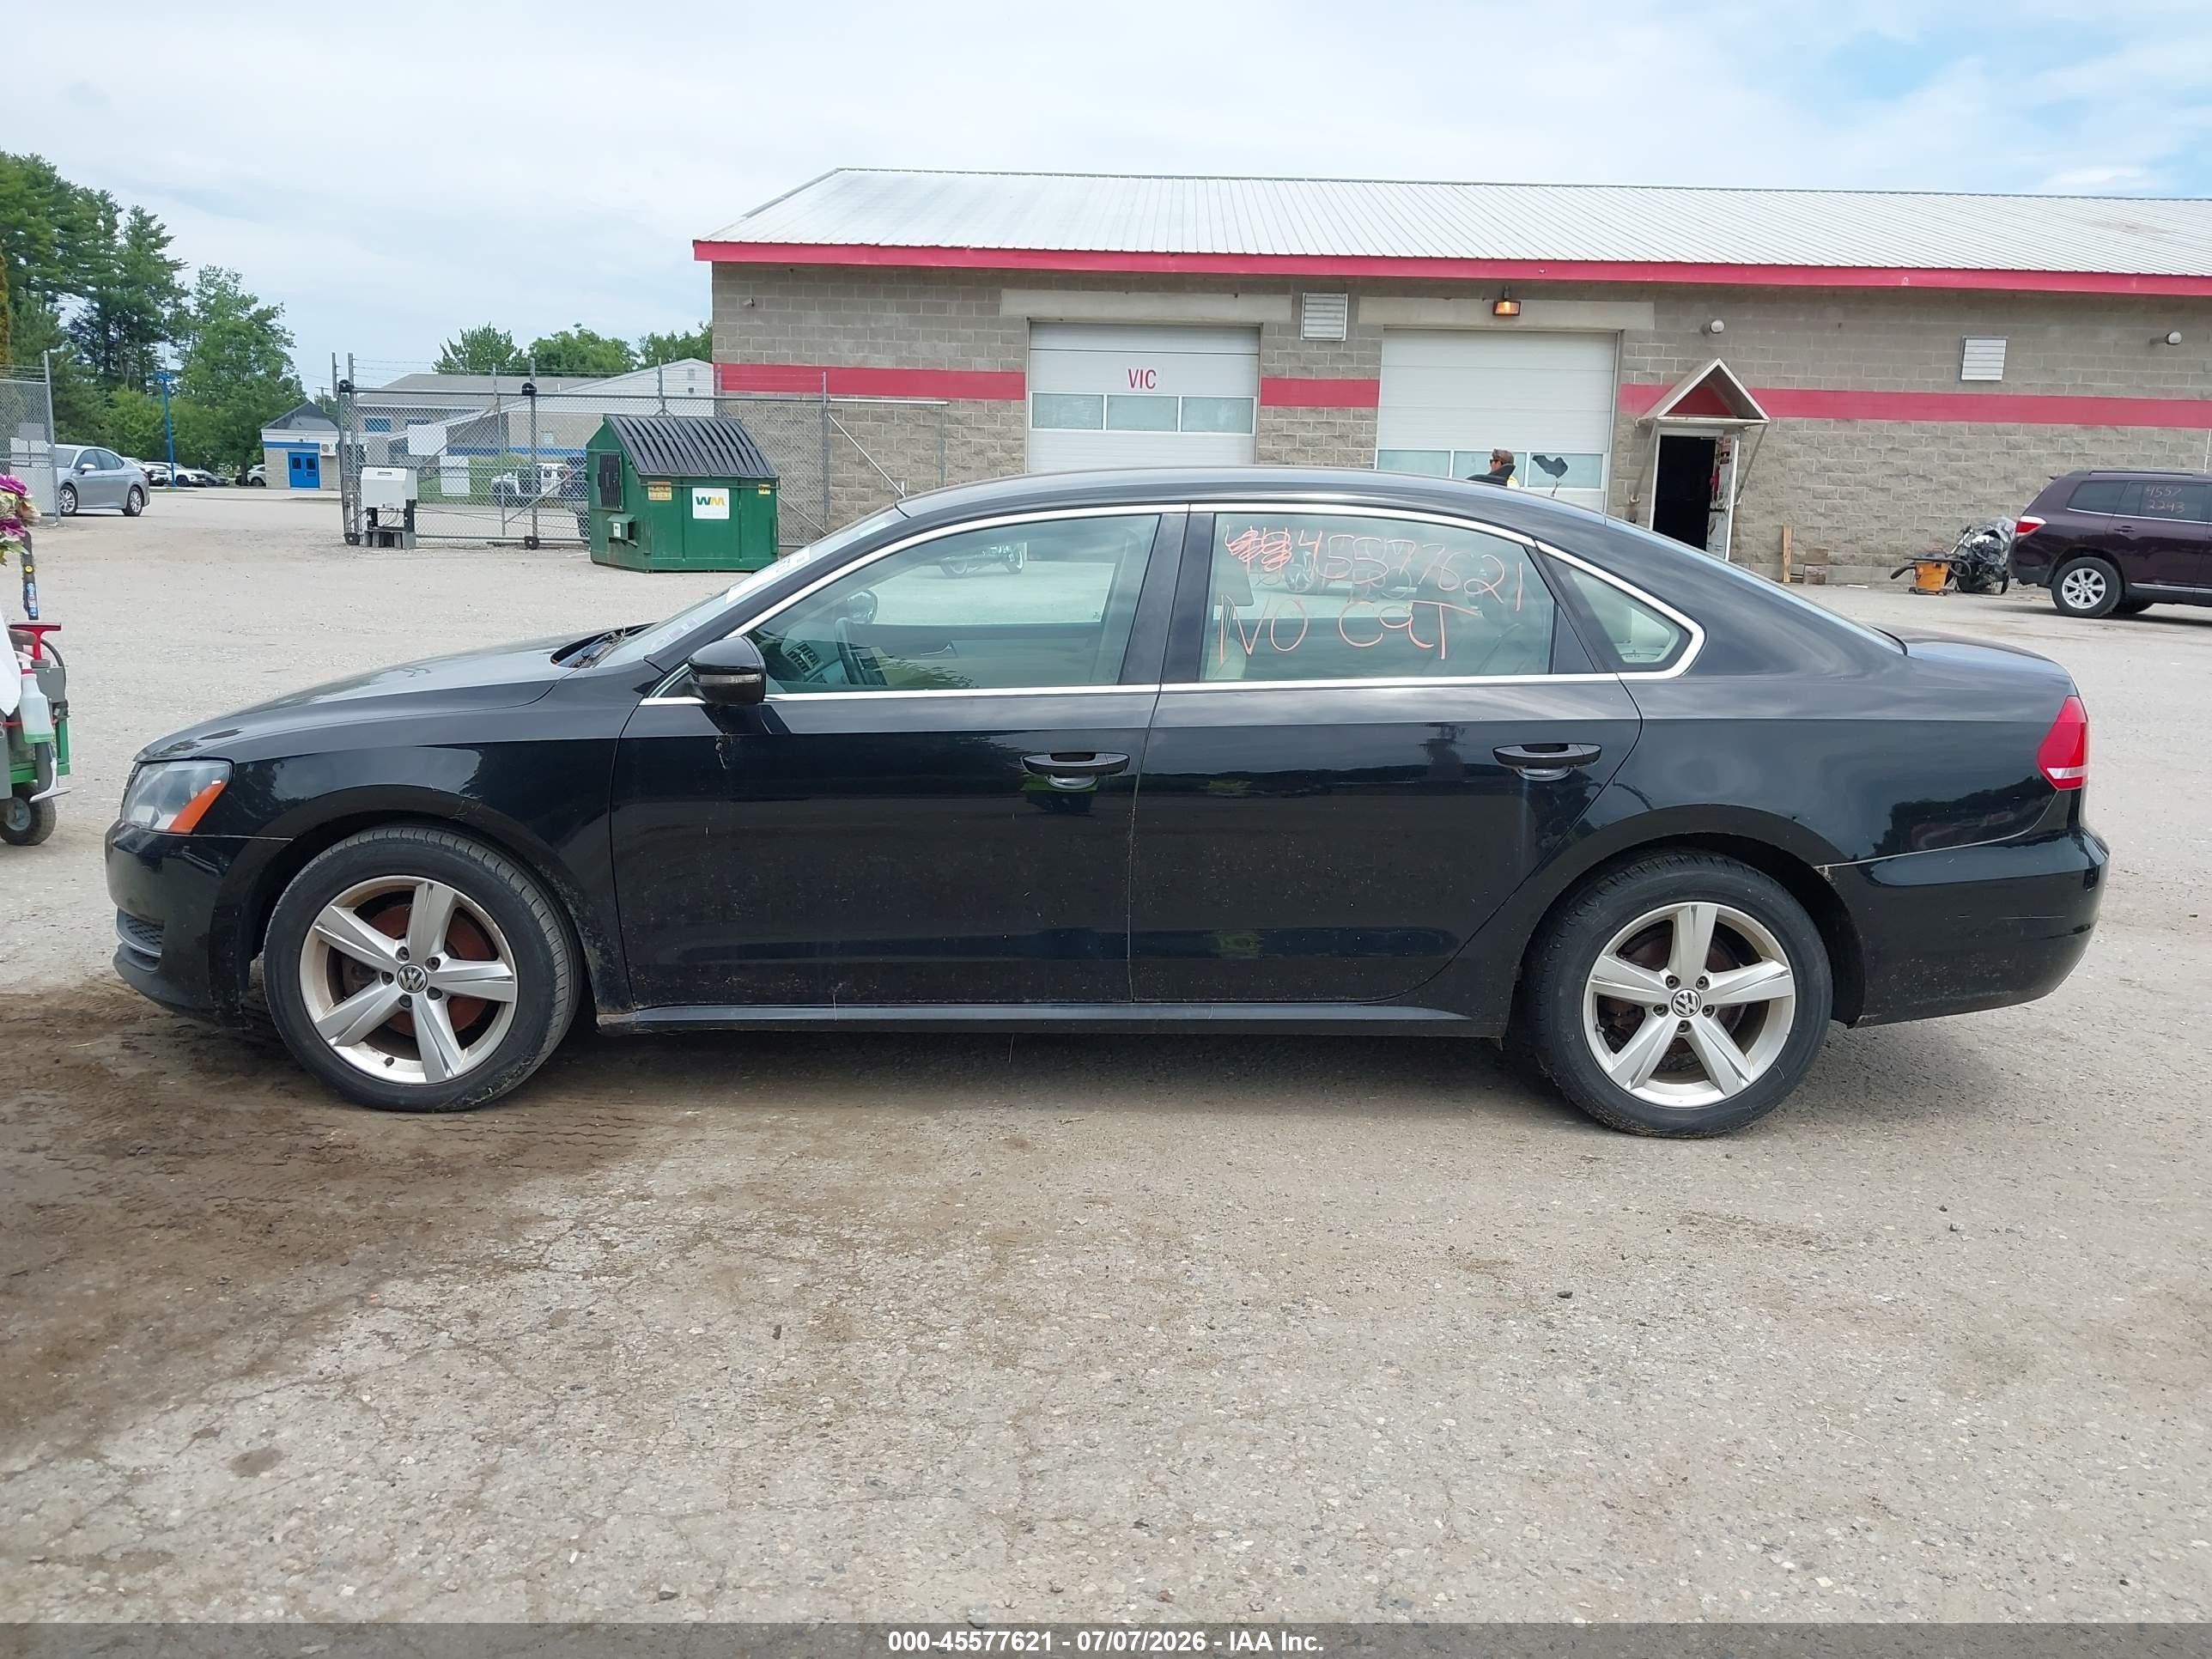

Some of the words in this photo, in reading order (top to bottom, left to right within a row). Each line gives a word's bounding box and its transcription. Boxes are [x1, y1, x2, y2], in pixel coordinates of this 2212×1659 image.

[1127, 368, 1157, 389] VIC
[2147, 486, 2182, 498] 4557
[695, 495, 725, 506] WM
[2149, 499, 2185, 514] 2243
[1218, 594, 1308, 664] NO
